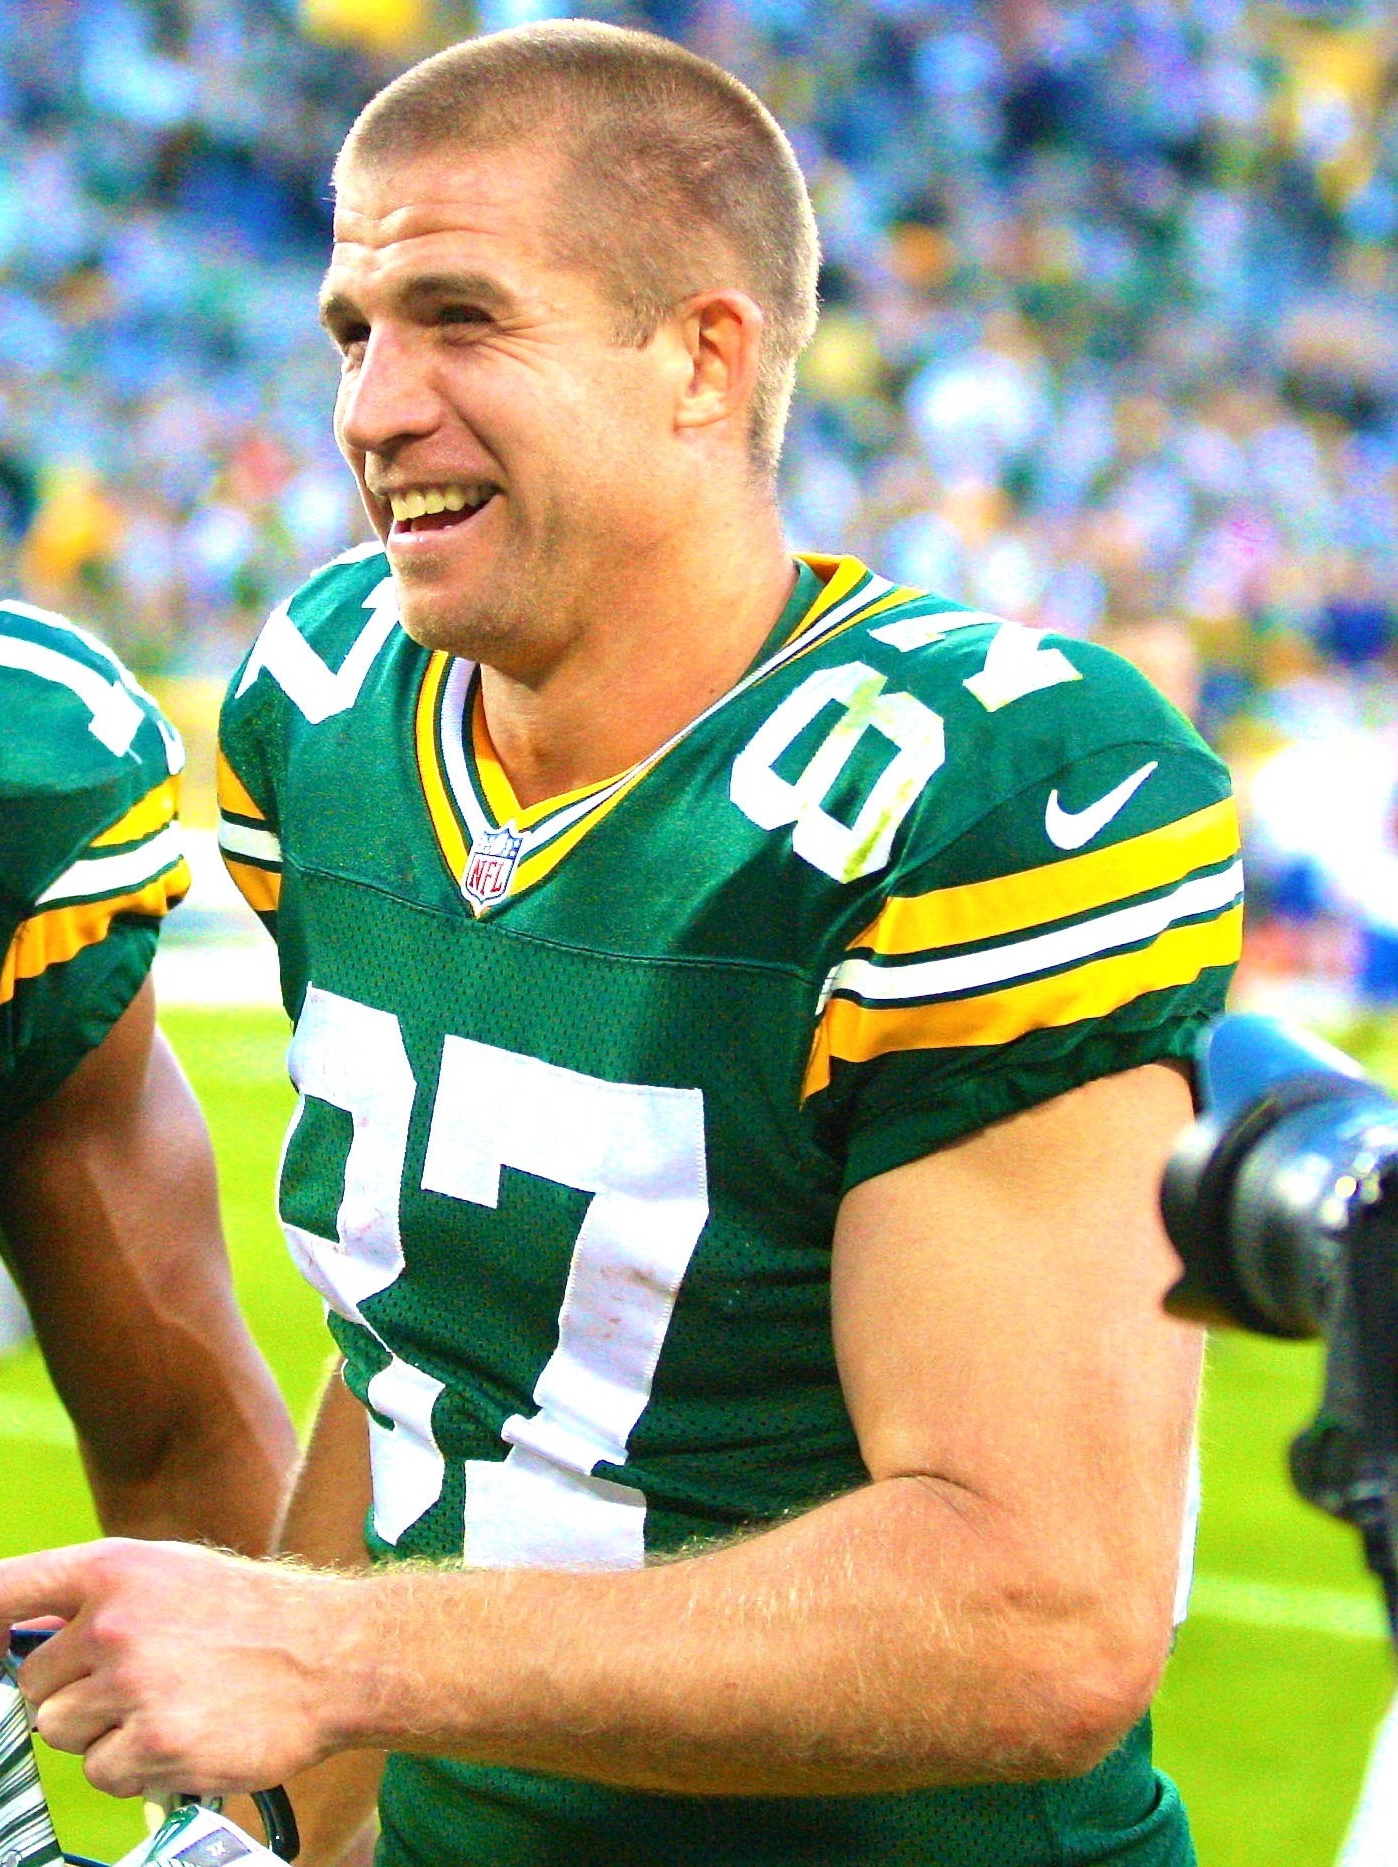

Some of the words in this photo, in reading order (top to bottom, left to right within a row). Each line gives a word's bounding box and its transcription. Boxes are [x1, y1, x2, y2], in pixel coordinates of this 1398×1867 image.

[235, 541, 401, 724] 7
[730, 610, 1083, 884] 87
[469, 858, 505, 896] NFL
[275, 981, 709, 1570] 87
